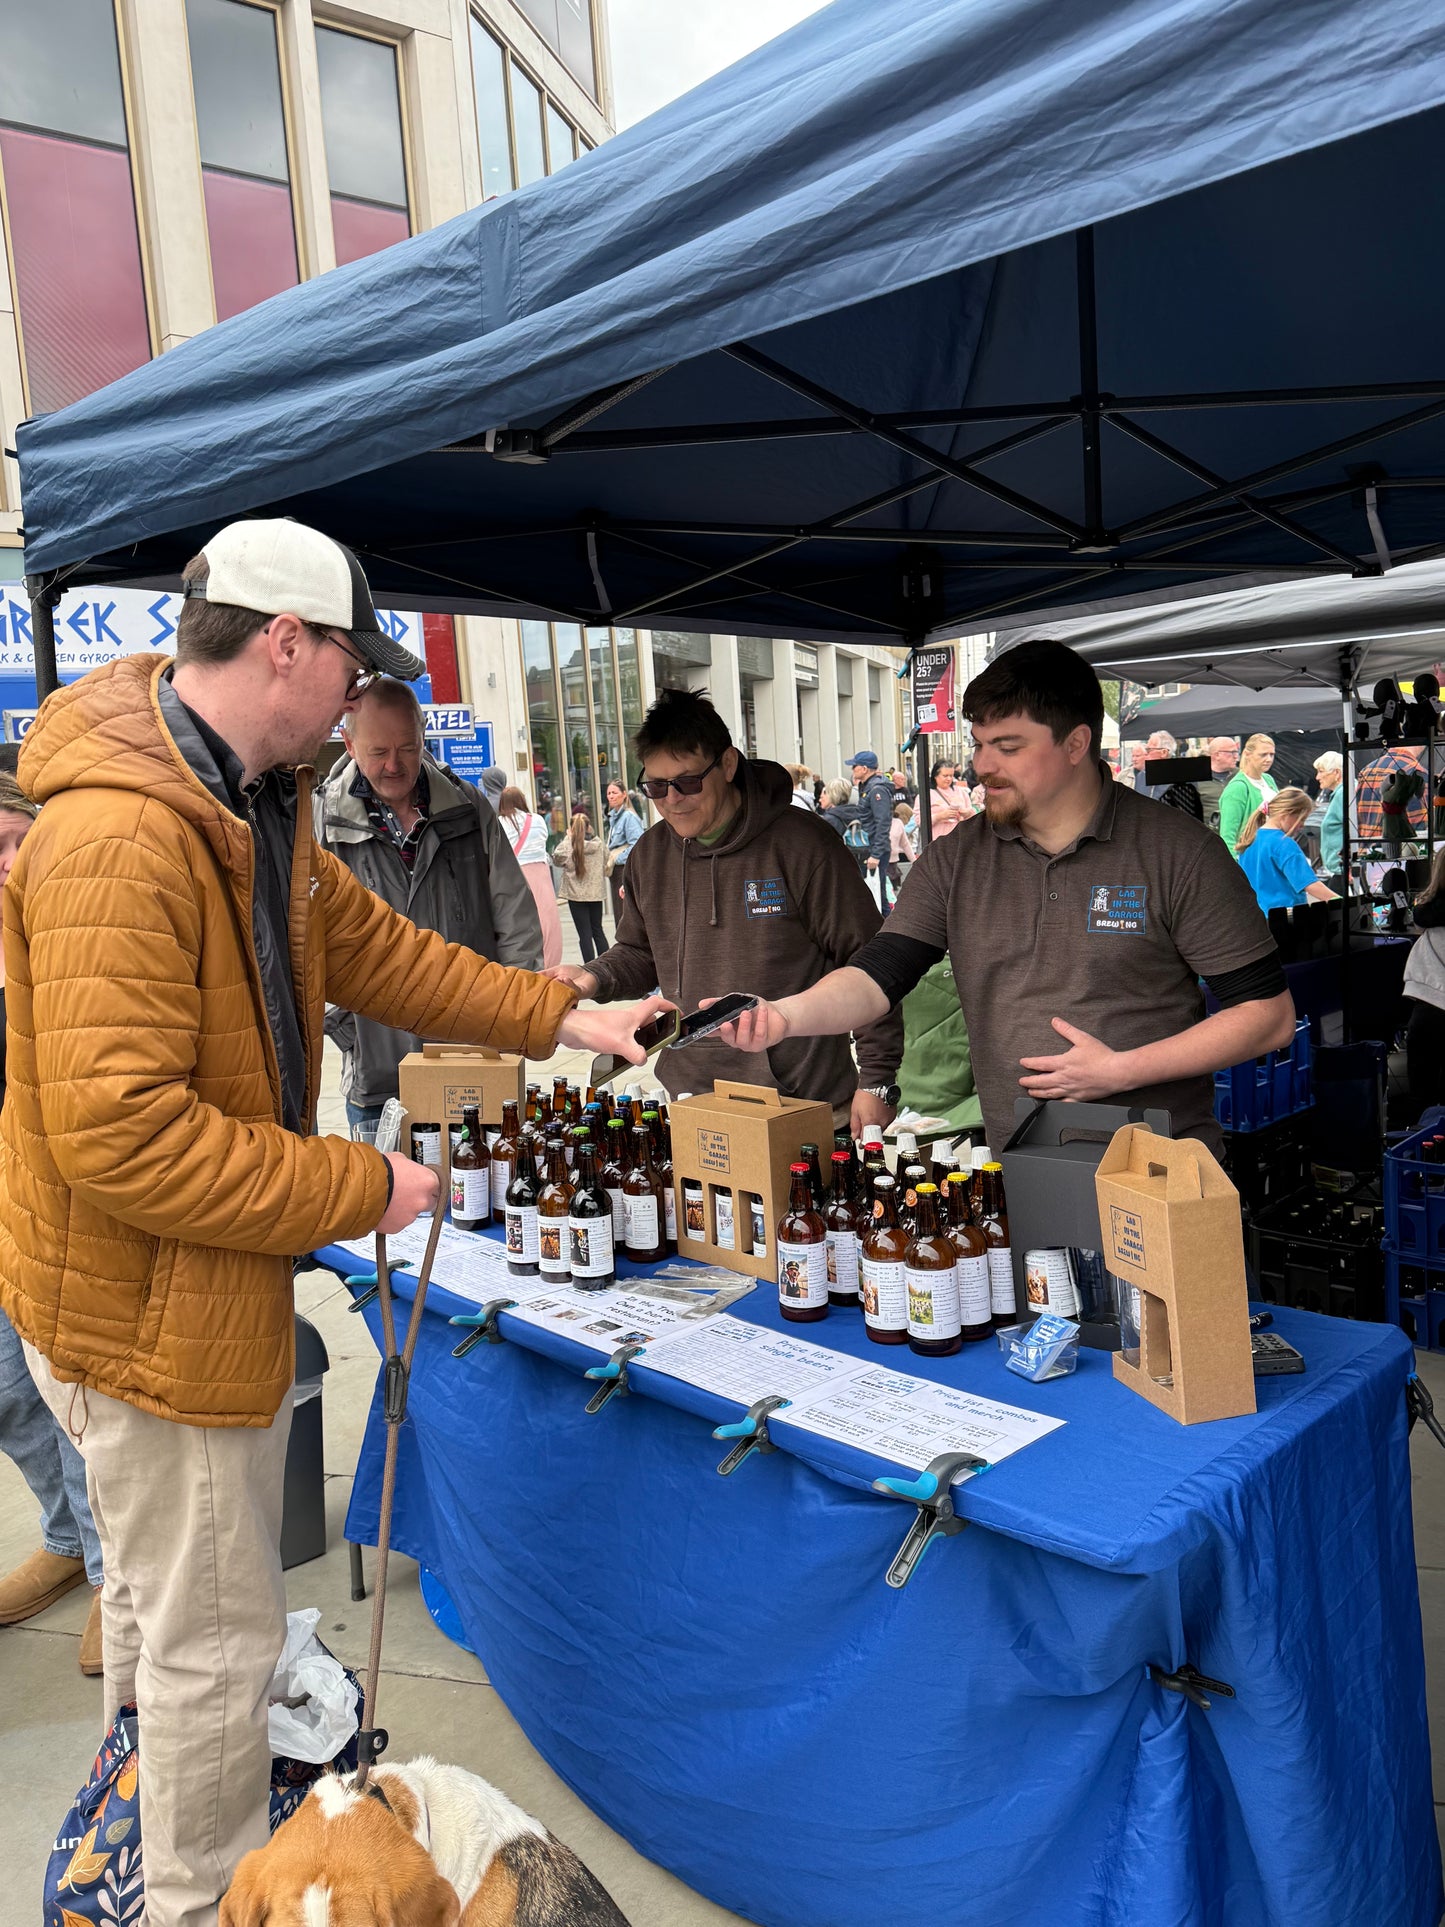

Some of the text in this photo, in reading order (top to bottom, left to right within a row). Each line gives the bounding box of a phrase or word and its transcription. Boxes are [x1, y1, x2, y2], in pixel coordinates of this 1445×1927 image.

[80, 653, 116, 664] GYROS
[916, 653, 947, 666] UNDER
[916, 666, 932, 678] 25?
[426, 710, 470, 729] AFEL
[1118, 890, 1136, 898] LAB
[709, 1151, 729, 1160] GARAGE
[760, 1344, 835, 1371] single beers
[776, 1340, 808, 1354] Price
[811, 1351, 834, 1361] list
[933, 1388, 961, 1401] Price
[964, 1398, 984, 1407] list
[995, 1408, 1038, 1423] combos
[944, 1400, 1004, 1421] and merch
